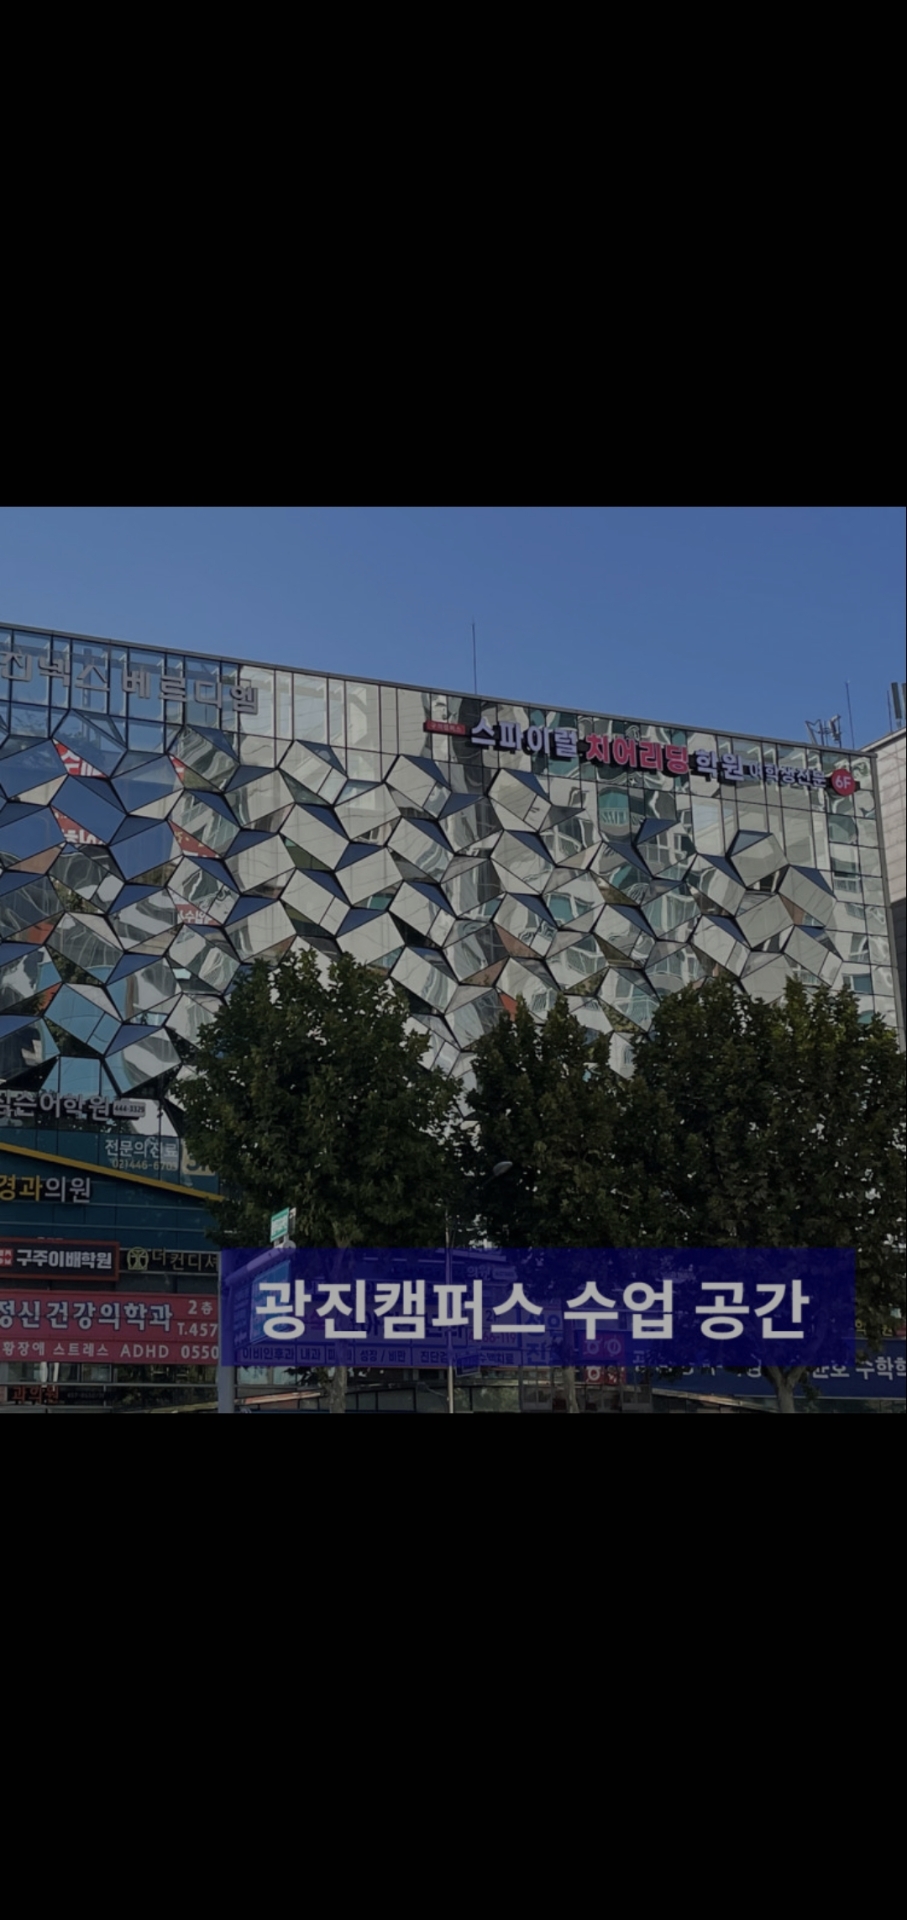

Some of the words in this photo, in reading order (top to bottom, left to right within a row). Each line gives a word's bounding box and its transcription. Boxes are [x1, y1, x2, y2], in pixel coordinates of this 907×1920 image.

[471, 716, 577, 757] 스파이럴
[586, 733, 689, 774] 치어리딩
[695, 749, 744, 780] 학원
[834, 777, 852, 790] 6F
[0, 1174, 91, 1203] 경과의원
[17, 1249, 112, 1270] 구주이배학원
[0, 1300, 172, 1331] 정신건강의학과
[188, 1300, 213, 1315] 2층
[3, 1341, 45, 1357] 황장애
[53, 1343, 109, 1356] 스트레스
[120, 1344, 169, 1359] ADHD
[180, 1344, 219, 1360] 0550
[242, 1348, 294, 1360] 이비인후과
[300, 1348, 321, 1360] 내과
